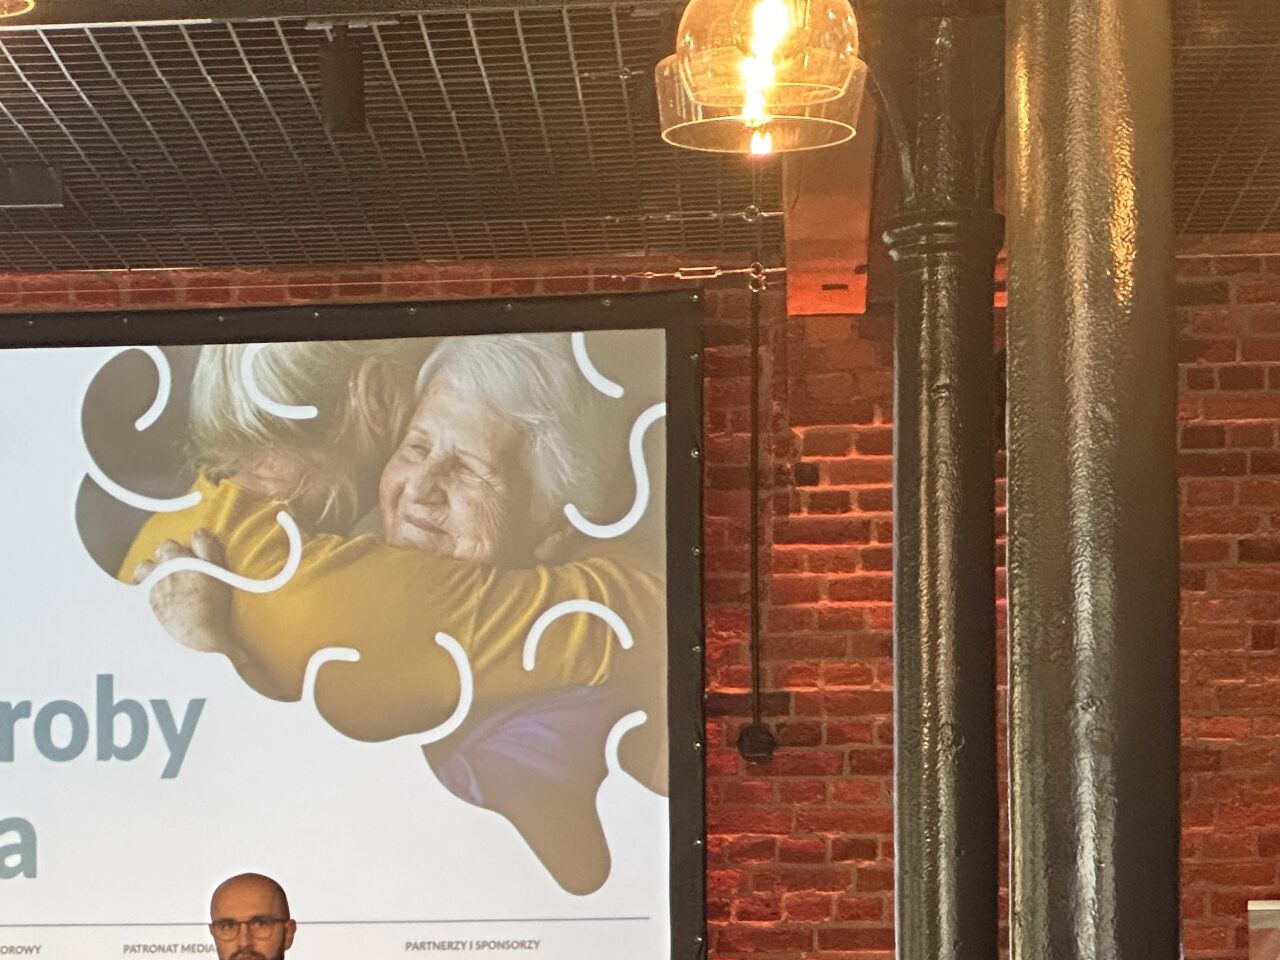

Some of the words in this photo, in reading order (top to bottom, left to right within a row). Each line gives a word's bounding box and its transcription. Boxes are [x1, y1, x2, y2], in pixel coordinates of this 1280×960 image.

[123, 943, 179, 954] PATRONAT
[181, 943, 217, 954] MEDIA
[405, 941, 468, 951] PARTNERZY
[475, 940, 541, 950] SPONSORZY
